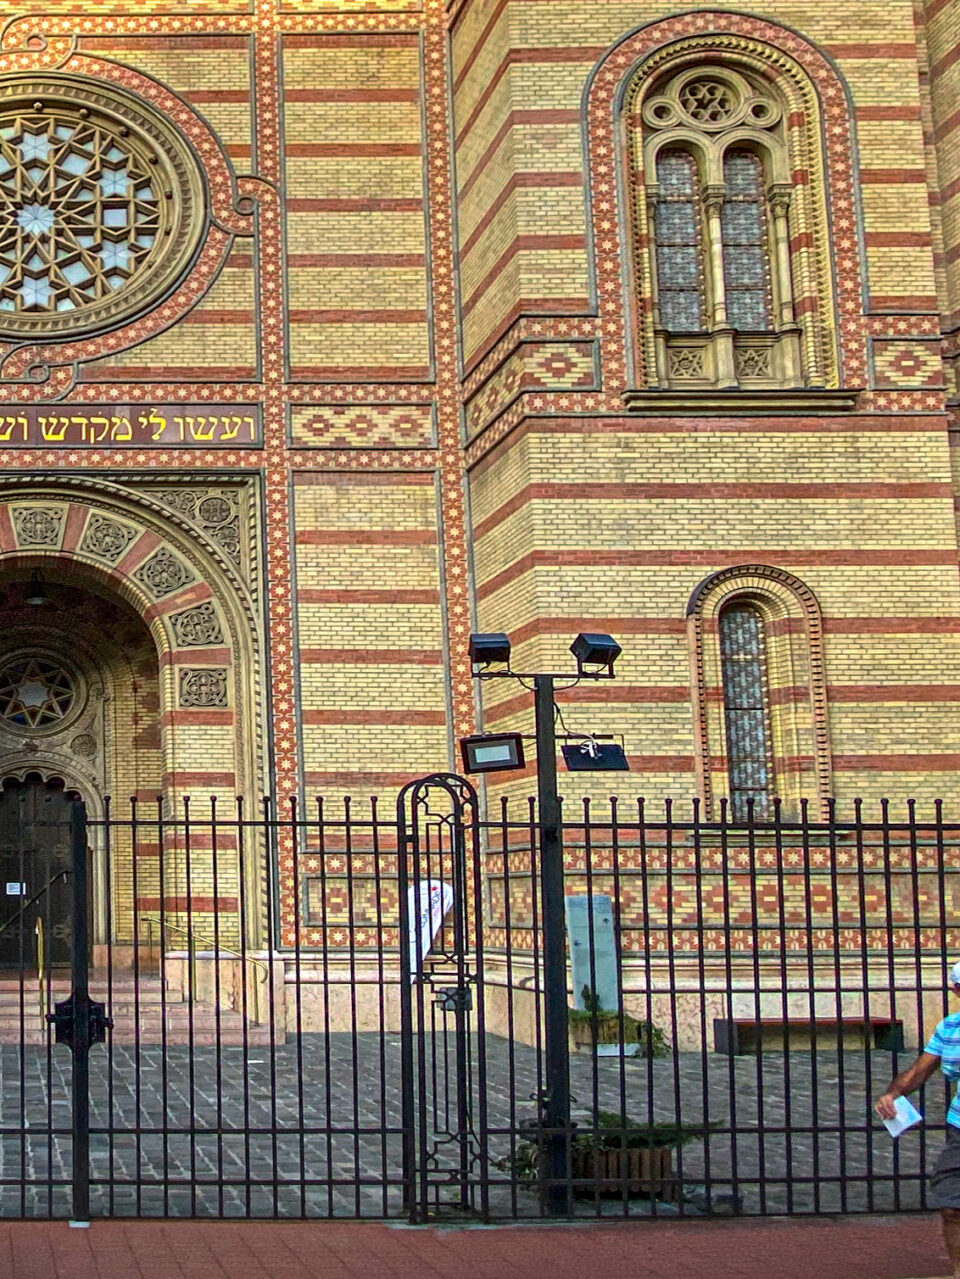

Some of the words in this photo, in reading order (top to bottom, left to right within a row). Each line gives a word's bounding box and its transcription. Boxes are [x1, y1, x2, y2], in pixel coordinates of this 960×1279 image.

[37, 416, 134, 444] מקדש
[138, 407, 167, 441] לי
[173, 416, 256, 441] ועשו
